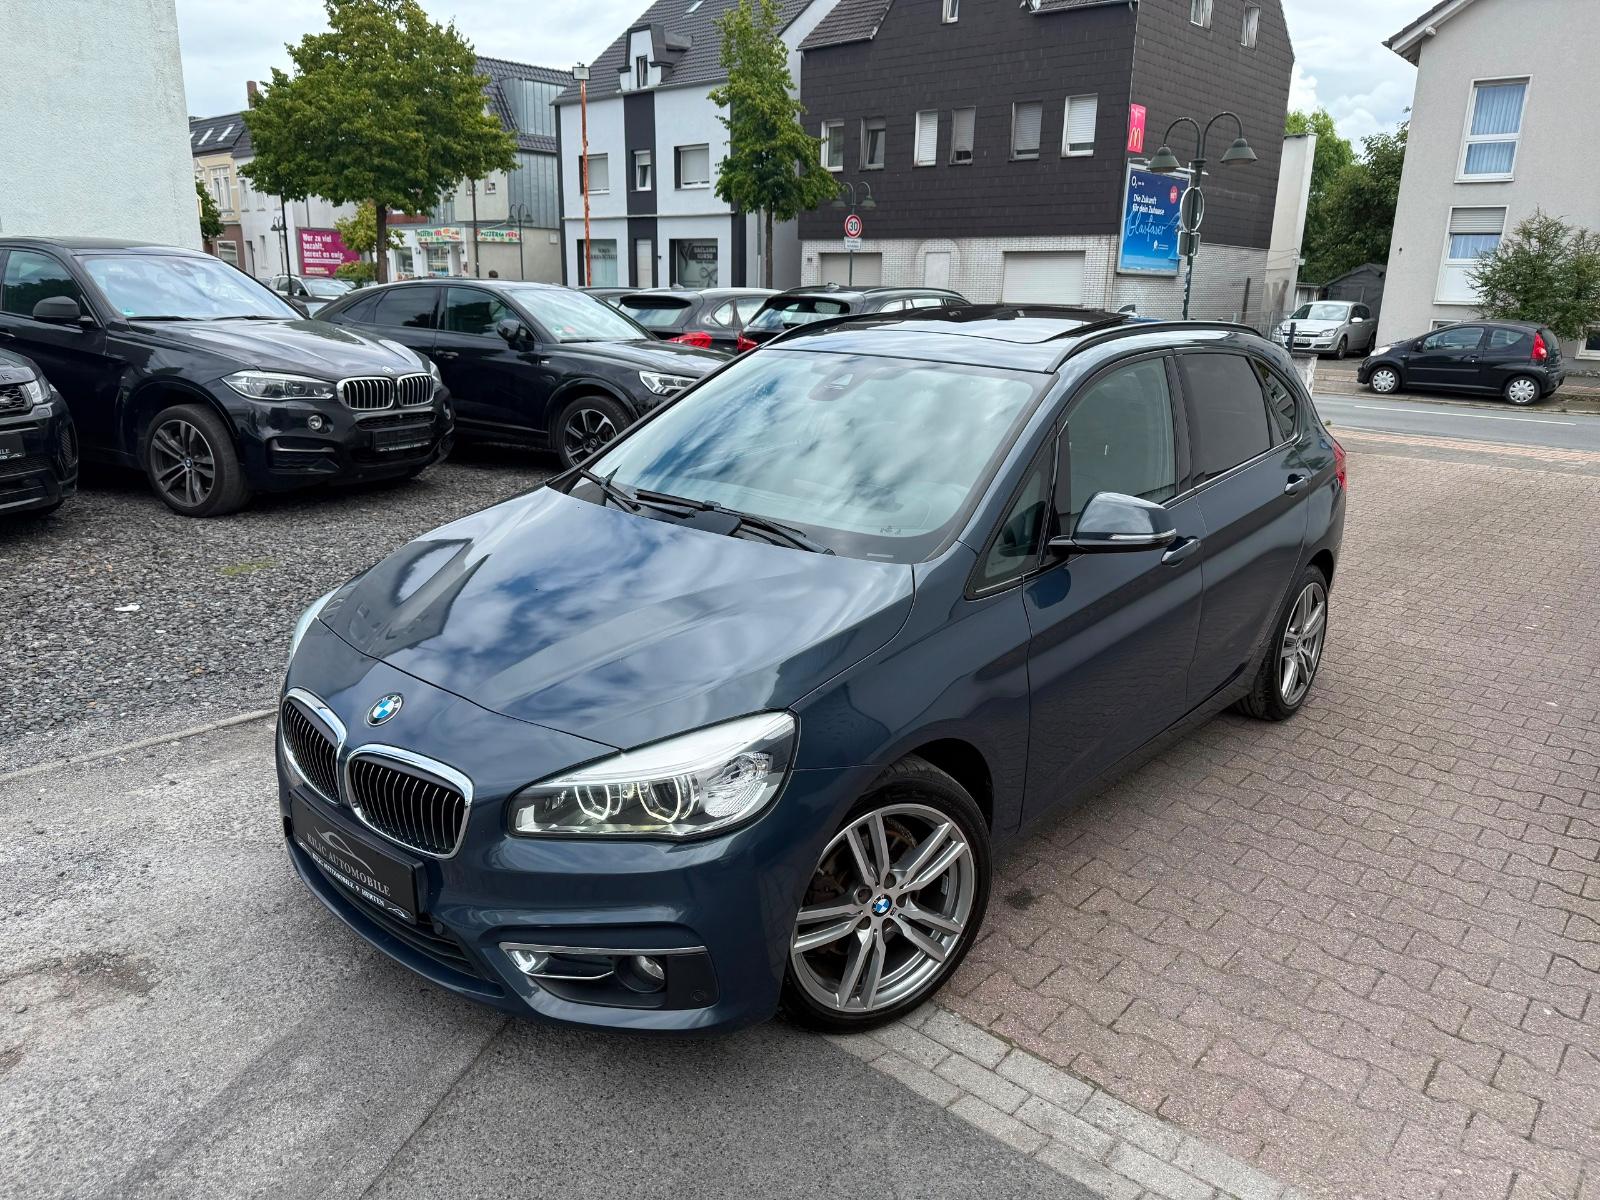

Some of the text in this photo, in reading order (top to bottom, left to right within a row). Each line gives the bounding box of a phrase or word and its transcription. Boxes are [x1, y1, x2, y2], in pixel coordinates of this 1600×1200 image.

[1133, 193, 1157, 205] Die Zukunft
[1132, 204, 1165, 216] für dein Zuhause
[849, 221, 859, 232] 30
[302, 233, 313, 242] Wer
[322, 234, 332, 243] viel
[303, 241, 325, 251] bezahlt,
[322, 251, 330, 259] es
[306, 832, 392, 898] BILIC AUTOMOBILE
[361, 887, 385, 907] HERTEN
